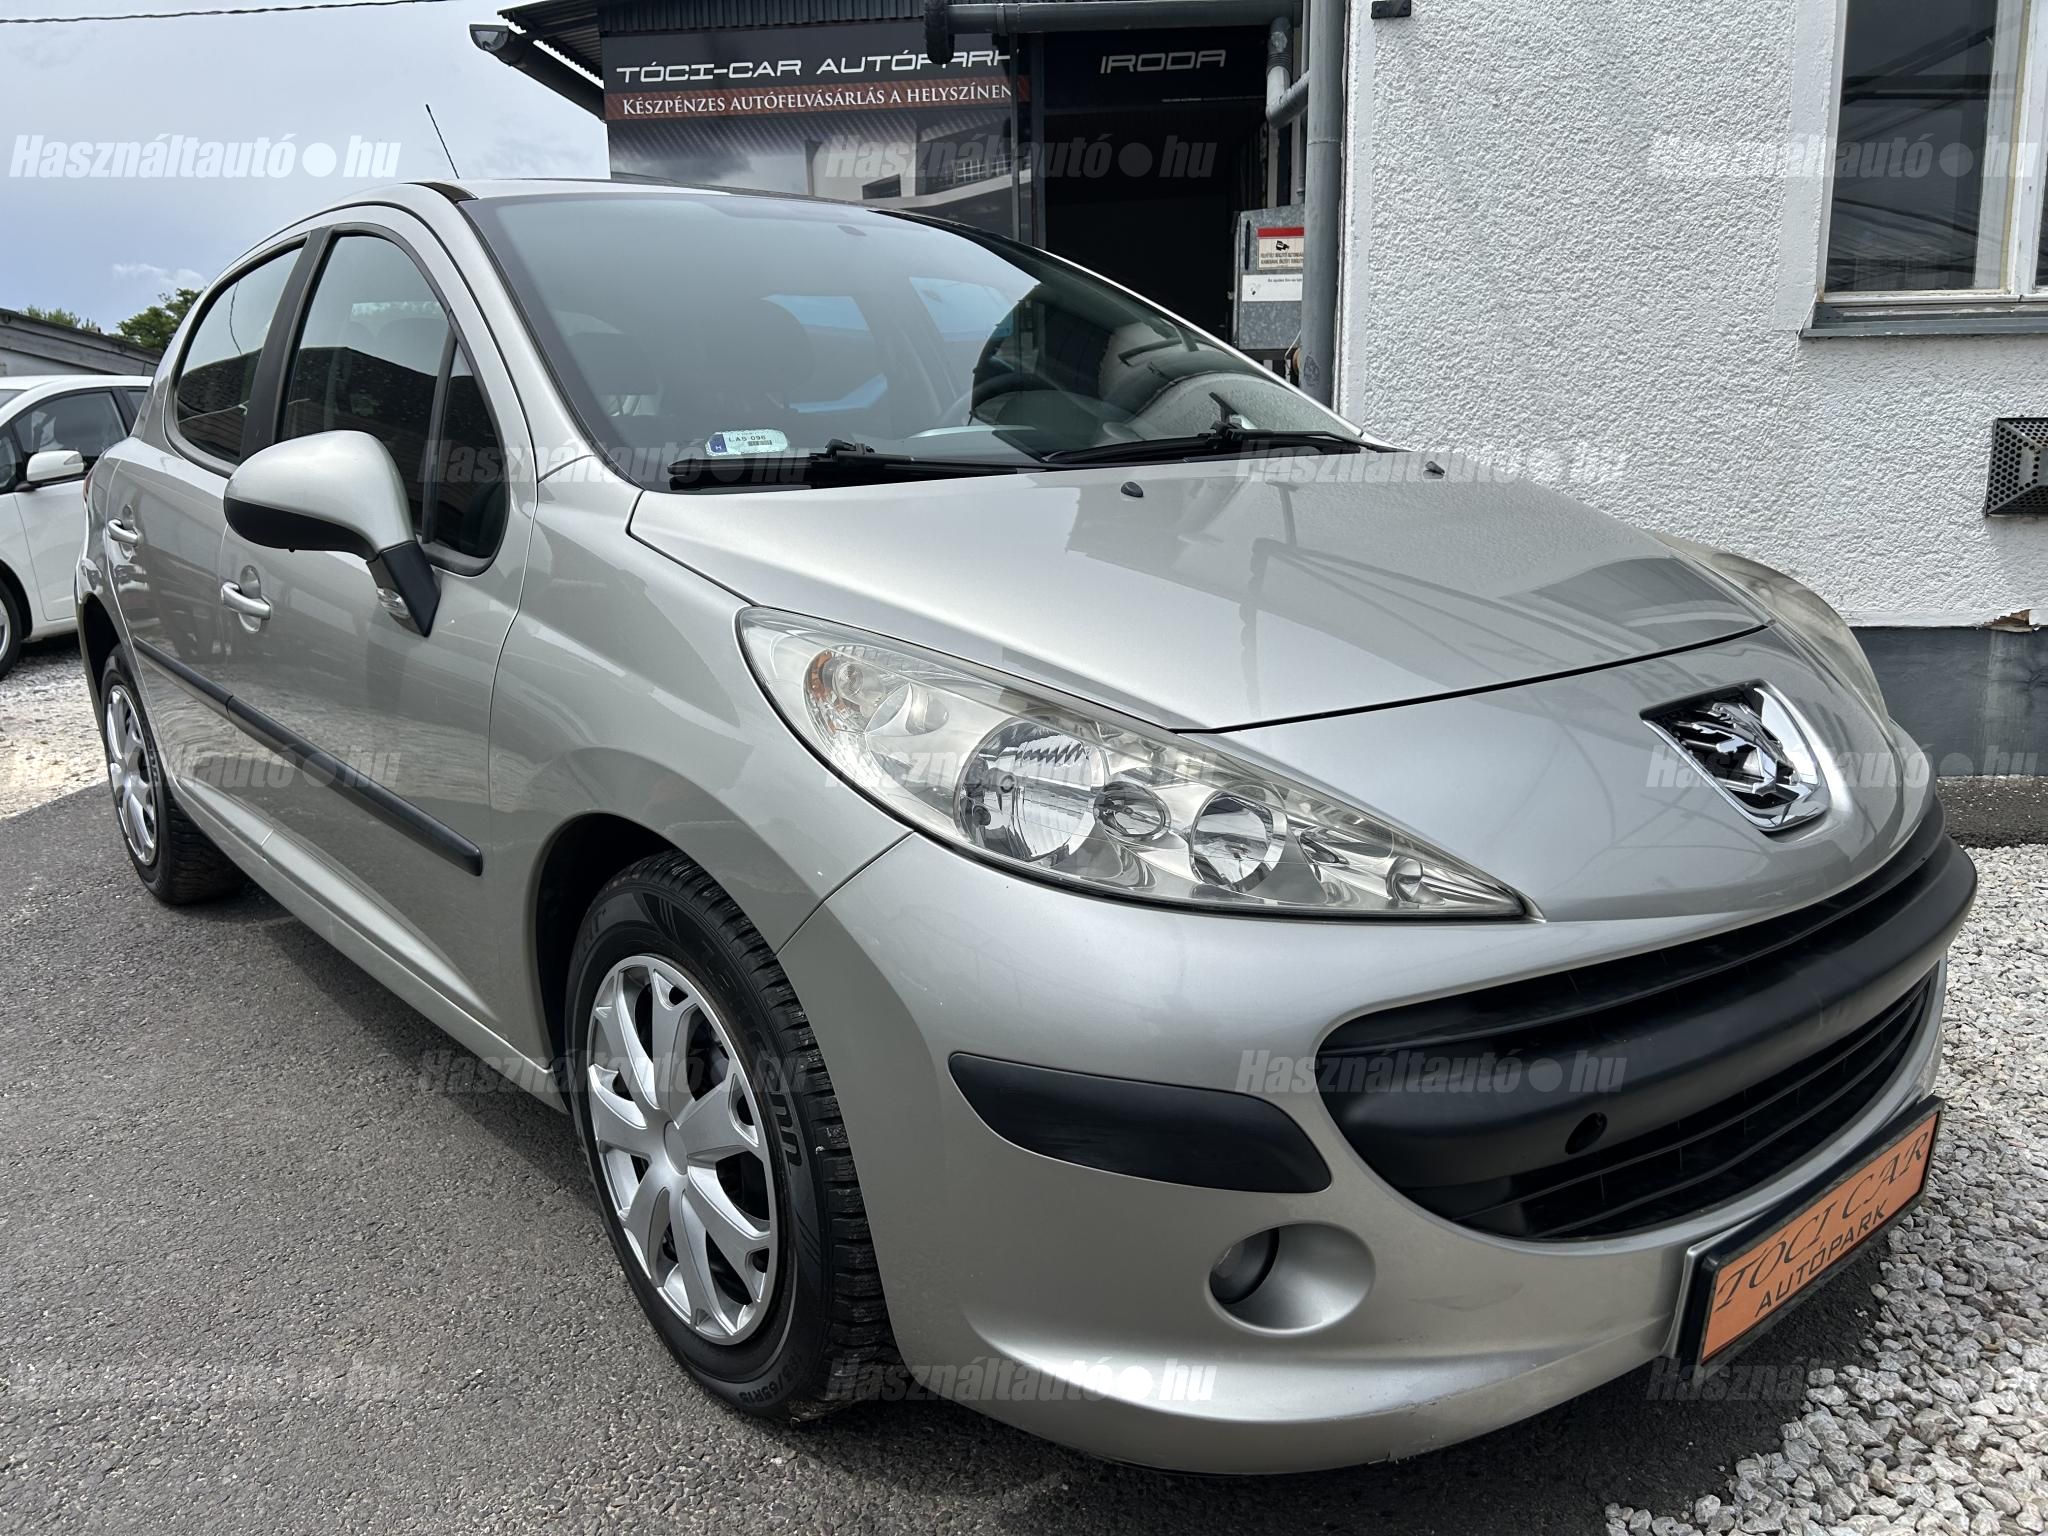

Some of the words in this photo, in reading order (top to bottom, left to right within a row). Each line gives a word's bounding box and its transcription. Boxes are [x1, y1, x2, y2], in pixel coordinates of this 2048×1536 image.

[616, 60, 802, 83] TÓCI-CAR
[1100, 50, 1226, 74] IRODA
[623, 96, 726, 115] KÉSZPÉNZES
[730, 86, 885, 111] AUTÓFELVÁSÁRLÁS
[890, 90, 902, 103] A
[1842, 1131, 1929, 1219] CAR
[1754, 1199, 1888, 1318] AUTÓPARK
